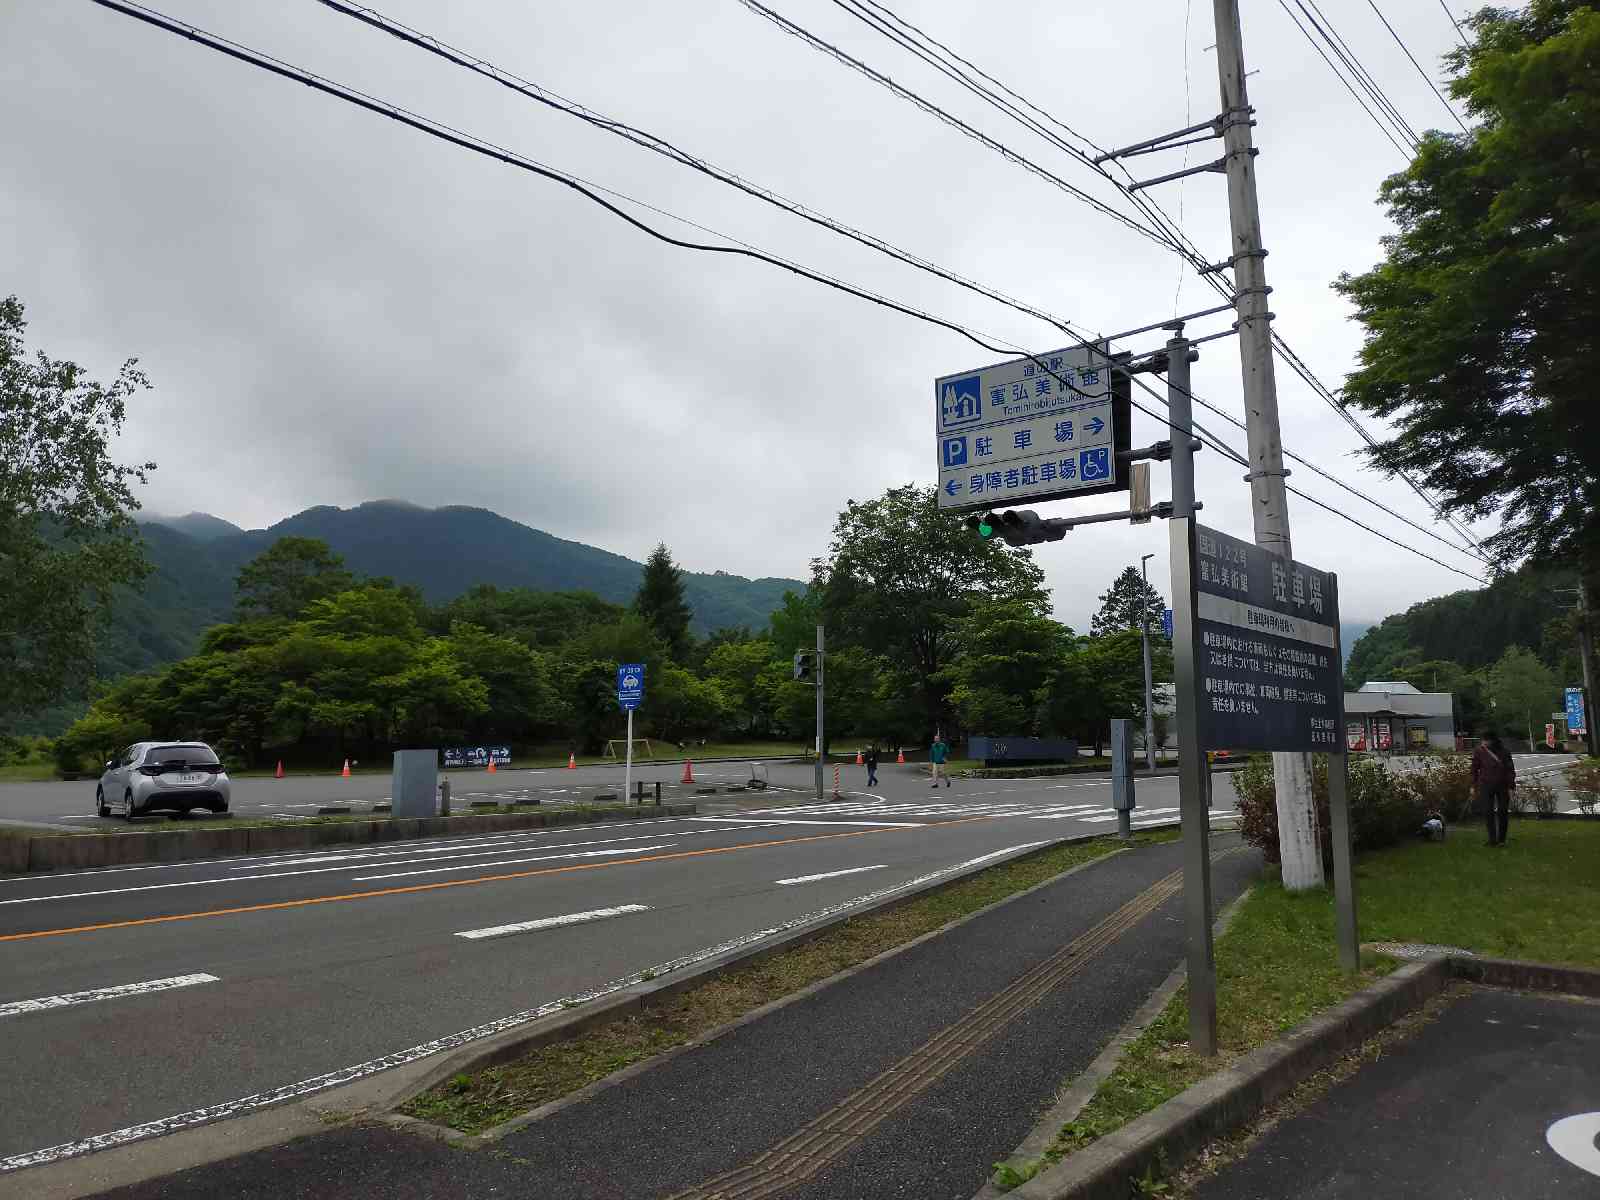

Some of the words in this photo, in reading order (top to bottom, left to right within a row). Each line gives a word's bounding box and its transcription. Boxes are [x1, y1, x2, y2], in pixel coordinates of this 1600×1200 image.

[1023, 357, 1064, 377] 道の駅
[974, 420, 1074, 457] 駐車場
[969, 458, 1077, 494] 身障者駐車場
[1272, 560, 1323, 615] 駐車場
